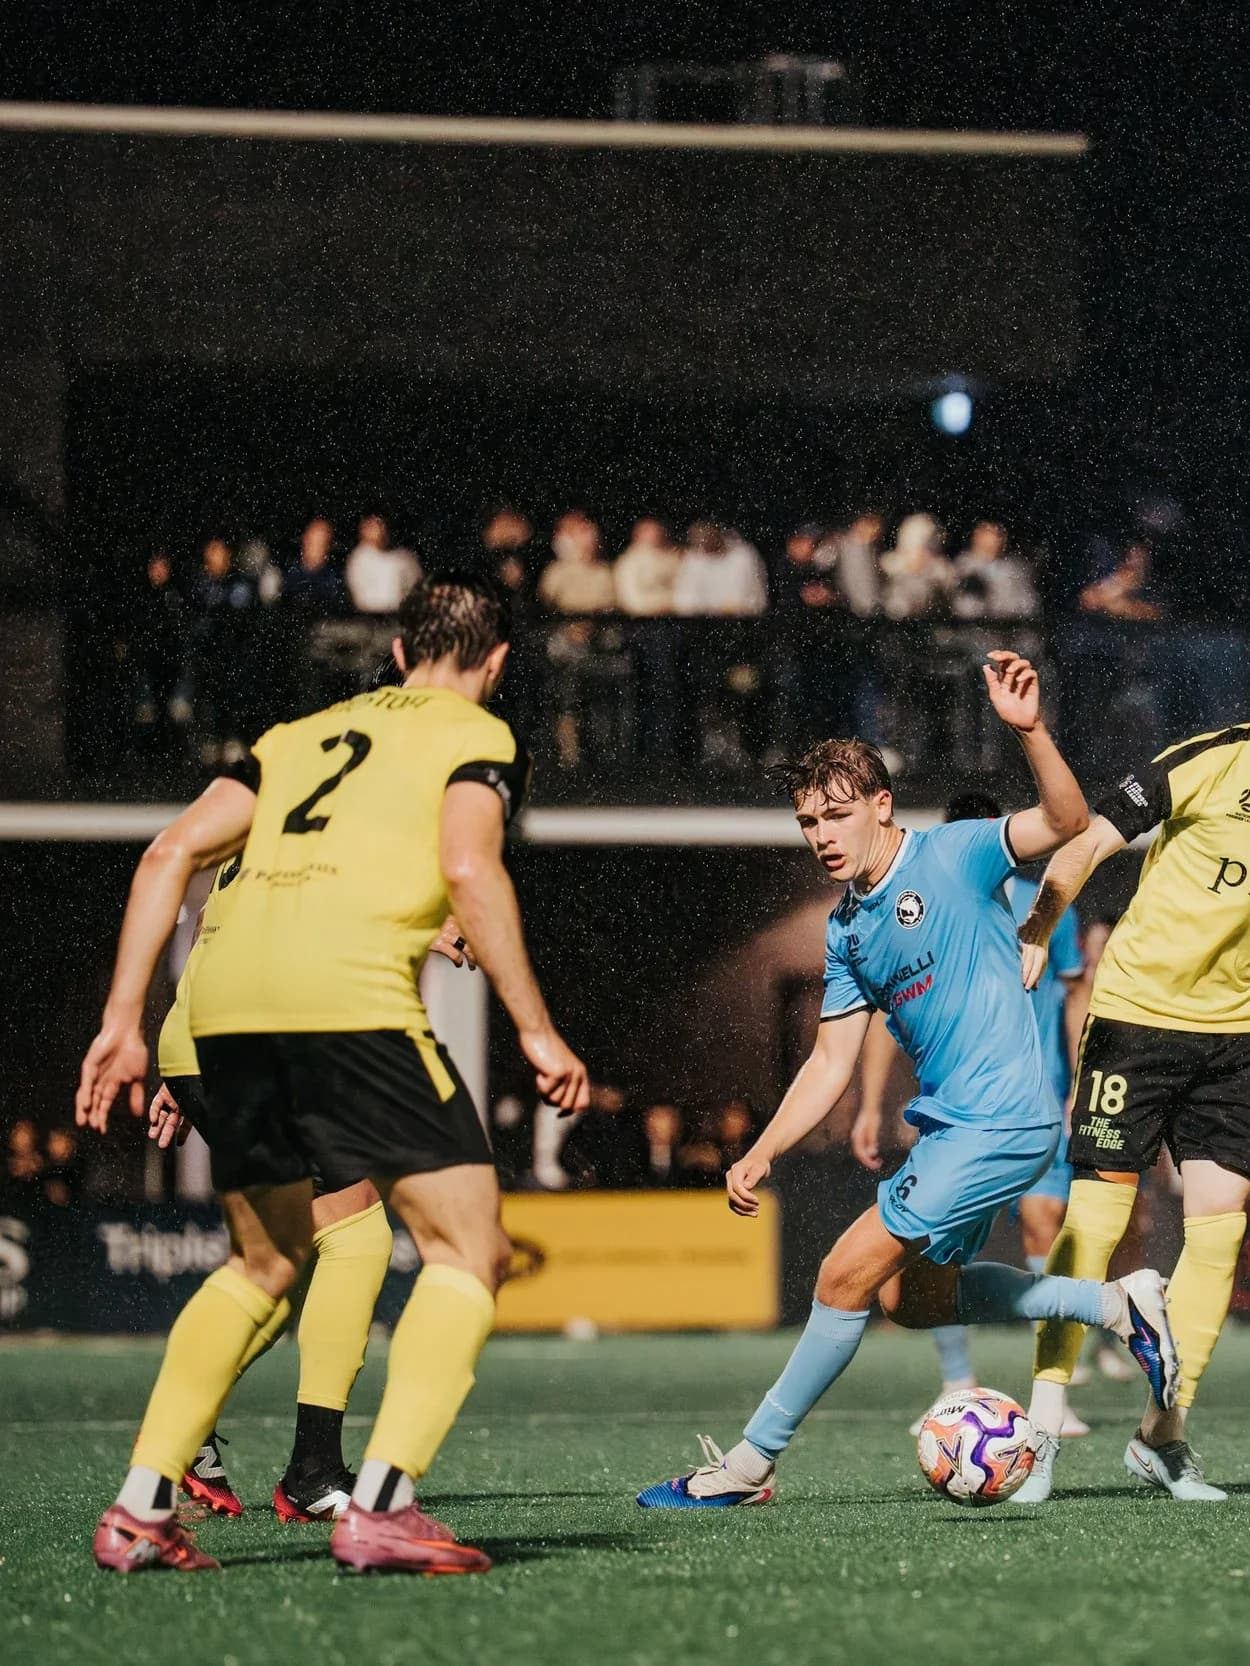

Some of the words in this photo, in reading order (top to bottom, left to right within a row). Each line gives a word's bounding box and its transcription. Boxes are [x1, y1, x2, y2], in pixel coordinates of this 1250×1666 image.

[281, 729, 372, 834] 2
[893, 974, 934, 1007] GWM
[1088, 1070, 1128, 1115] 18
[1078, 1125, 1121, 1139] FITNESS
[1090, 1116, 1112, 1129] THE
[1096, 1138, 1125, 1150] EDGE
[896, 1174, 918, 1201] 6
